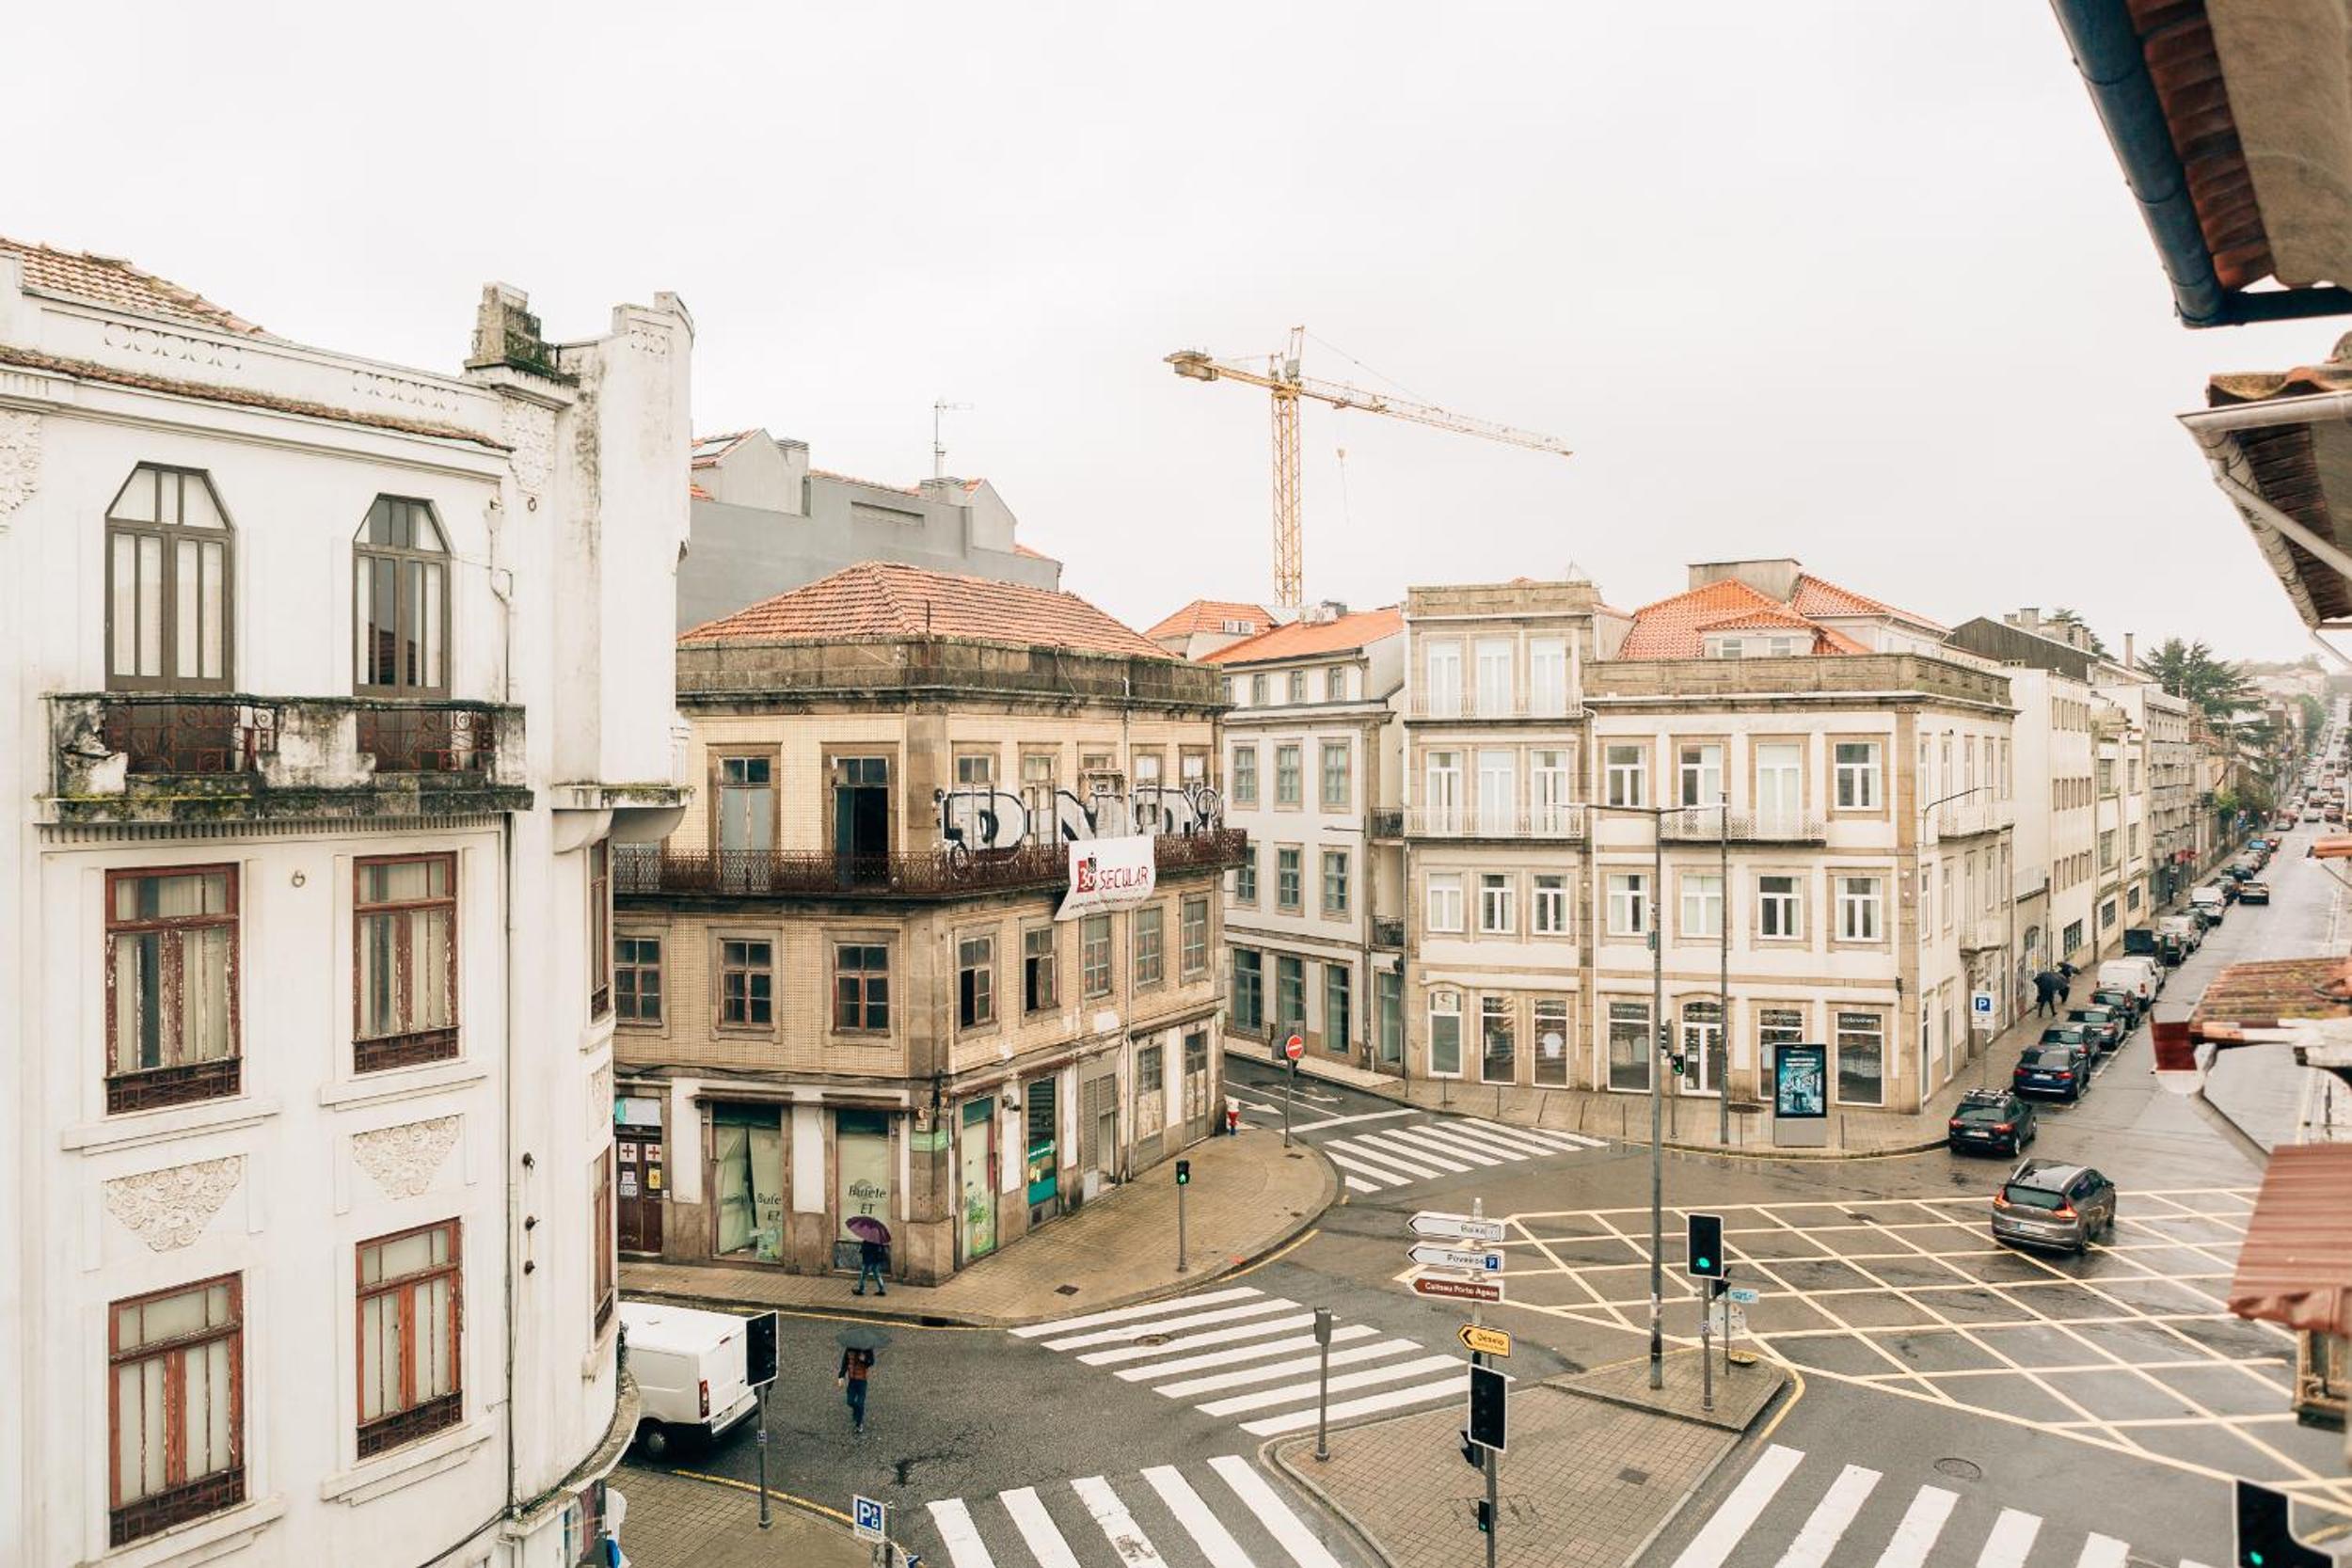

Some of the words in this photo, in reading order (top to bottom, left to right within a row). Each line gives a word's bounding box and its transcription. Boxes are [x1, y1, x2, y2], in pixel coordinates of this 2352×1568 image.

[1100, 866, 1149, 890] SECULAR
[1978, 998, 1989, 1011] P
[1454, 1286, 1474, 1295] Porto
[859, 1501, 871, 1523] P
